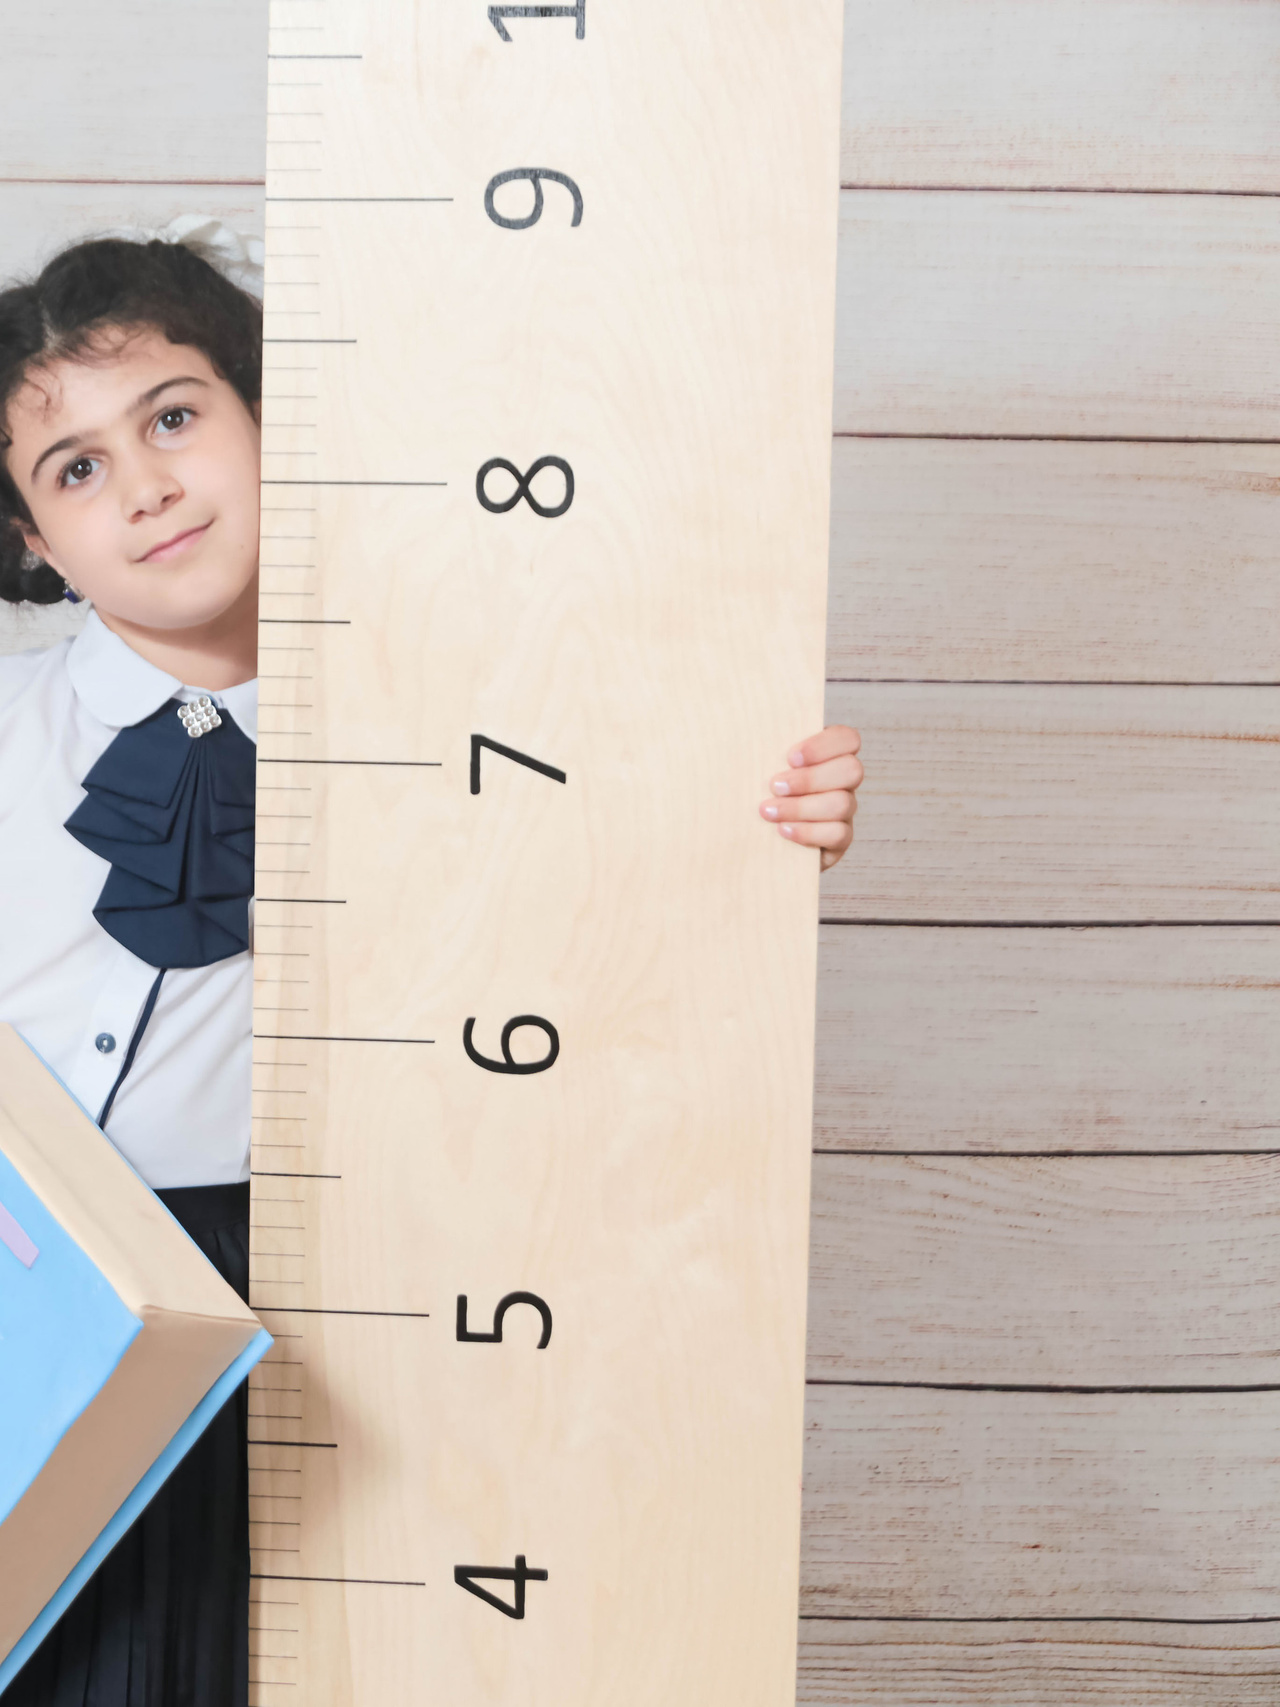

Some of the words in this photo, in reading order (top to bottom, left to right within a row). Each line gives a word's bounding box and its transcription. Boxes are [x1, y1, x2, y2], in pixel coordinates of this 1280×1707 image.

[484, 167, 584, 230] 9
[475, 455, 575, 519] 8
[469, 733, 567, 796] 7
[462, 1014, 560, 1076] 6
[455, 1290, 553, 1350] 5
[453, 1554, 549, 1621] 4
